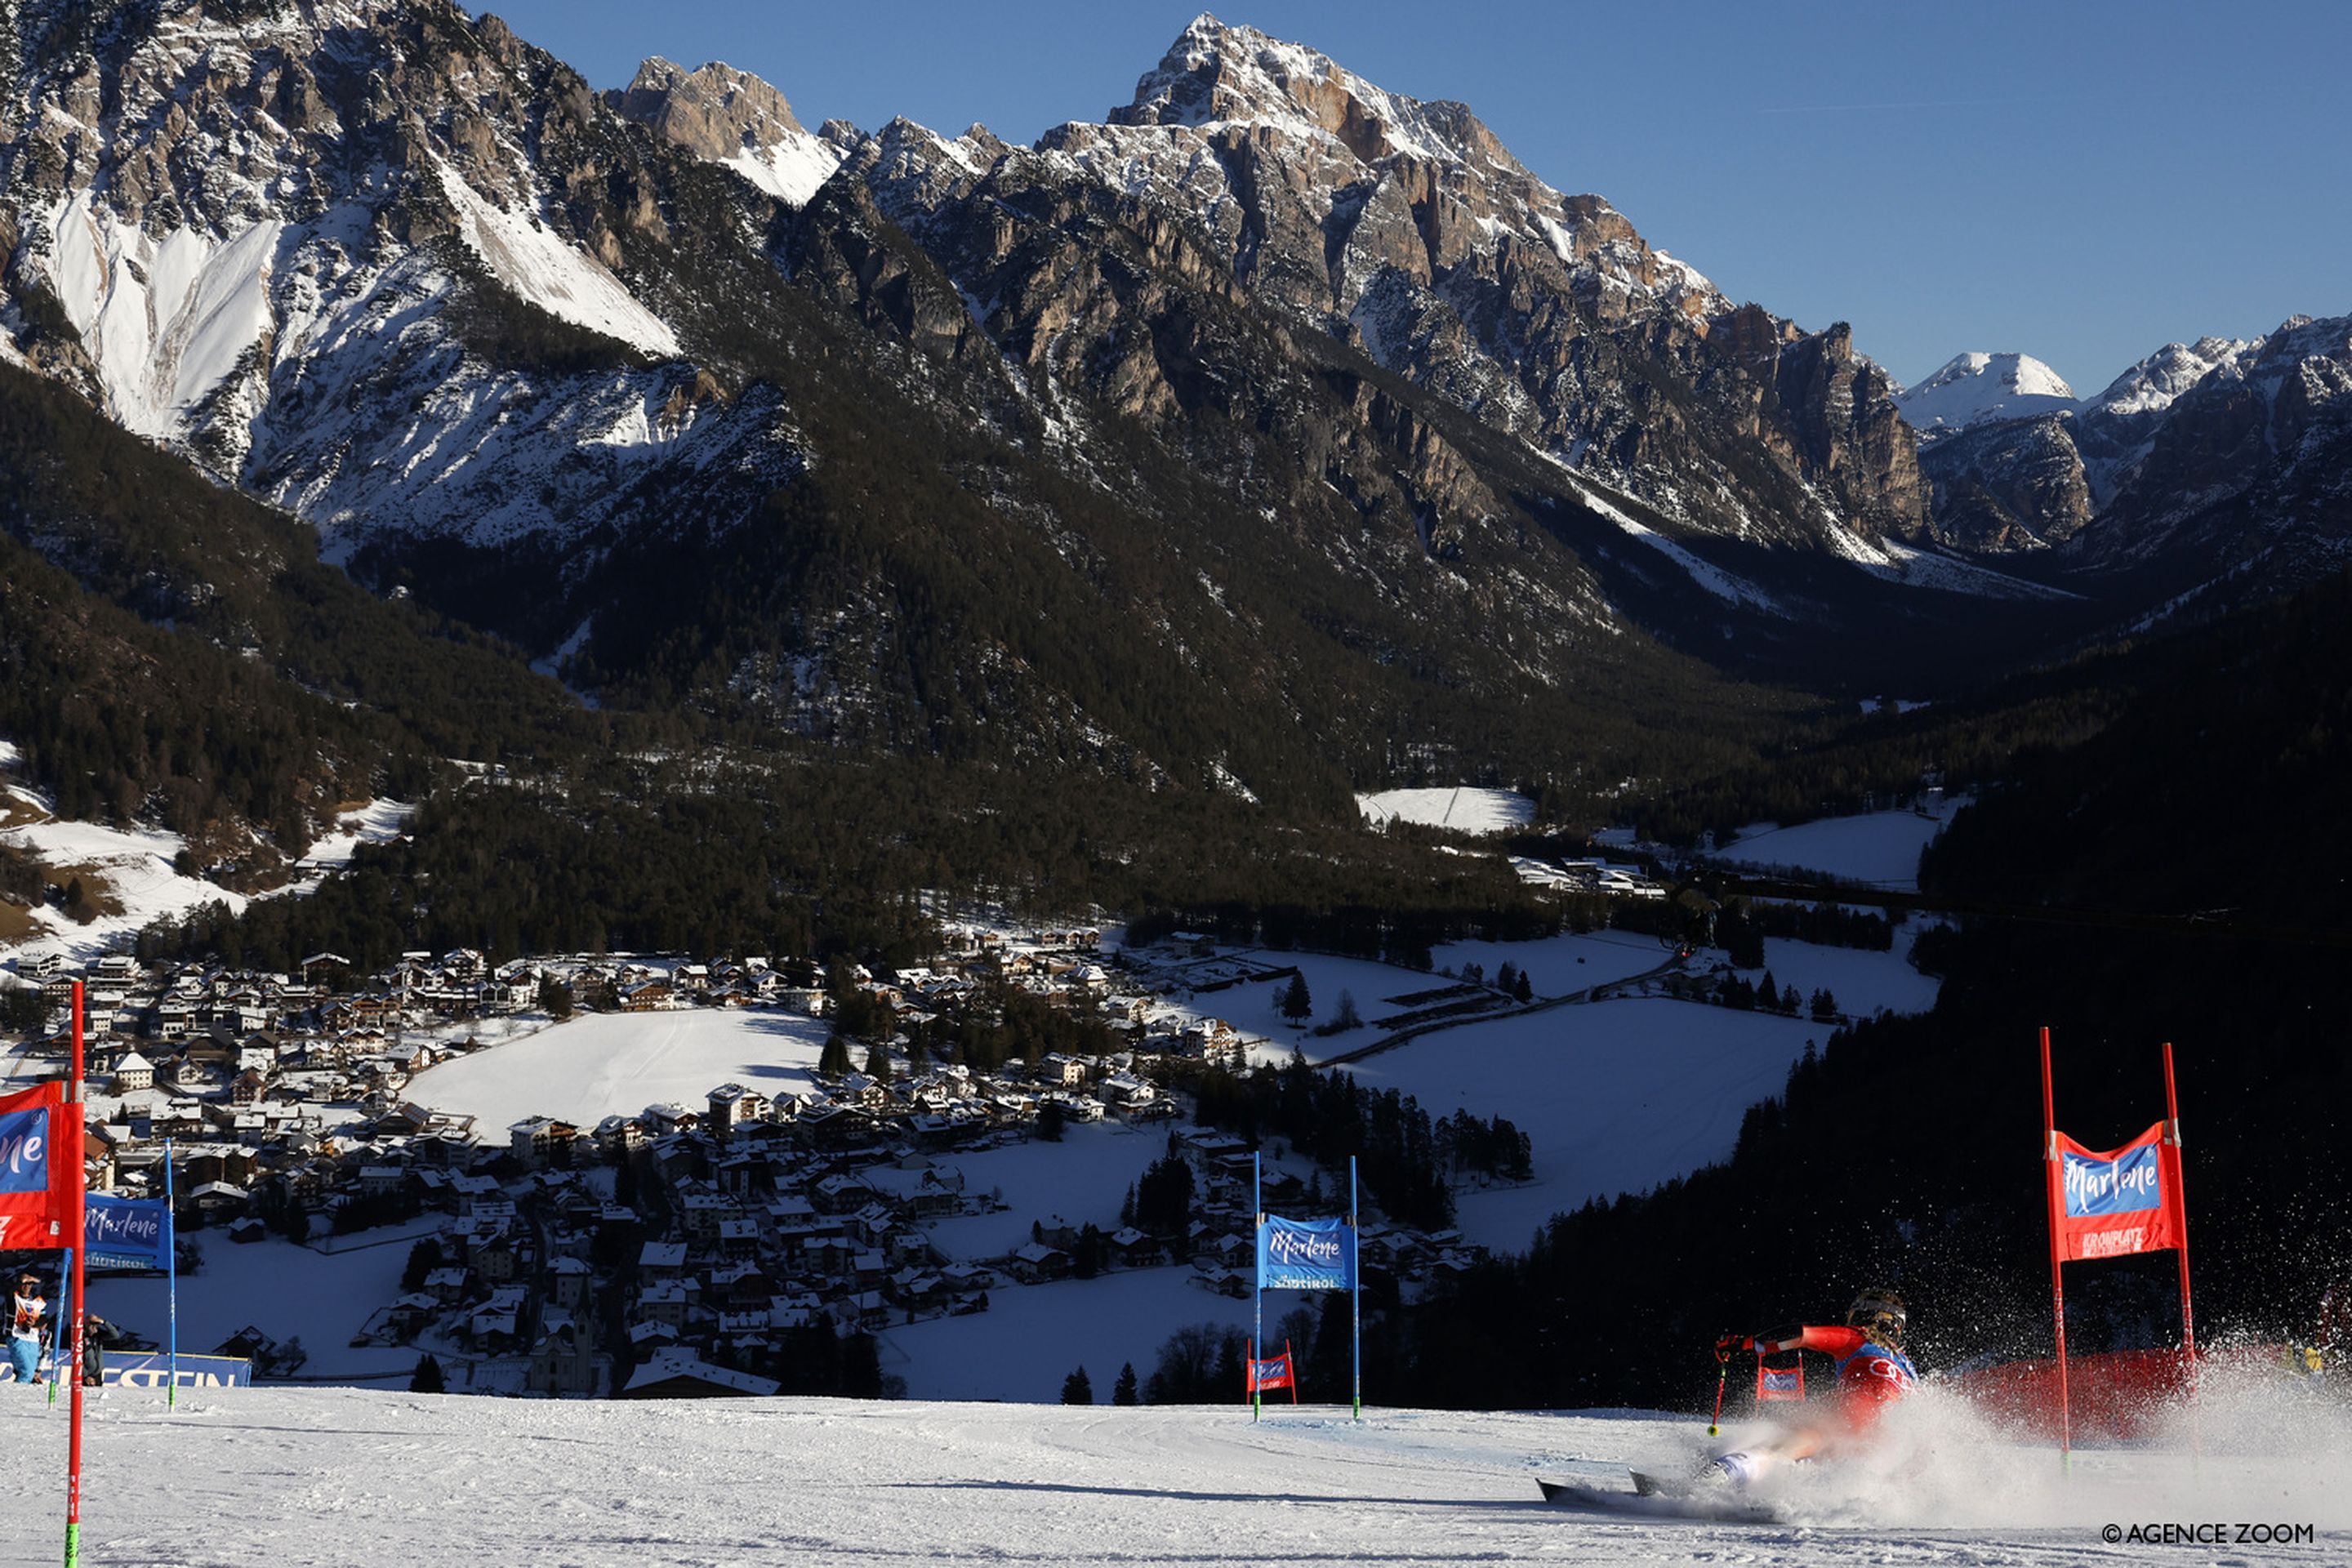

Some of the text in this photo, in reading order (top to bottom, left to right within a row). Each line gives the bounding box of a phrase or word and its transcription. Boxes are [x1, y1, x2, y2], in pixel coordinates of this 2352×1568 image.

[2066, 1159, 2156, 1214] Marlene
[84, 1208, 158, 1241] Marlene
[2082, 1227, 2144, 1249] KRONPLATZ
[1270, 1230, 1339, 1264] Marlene
